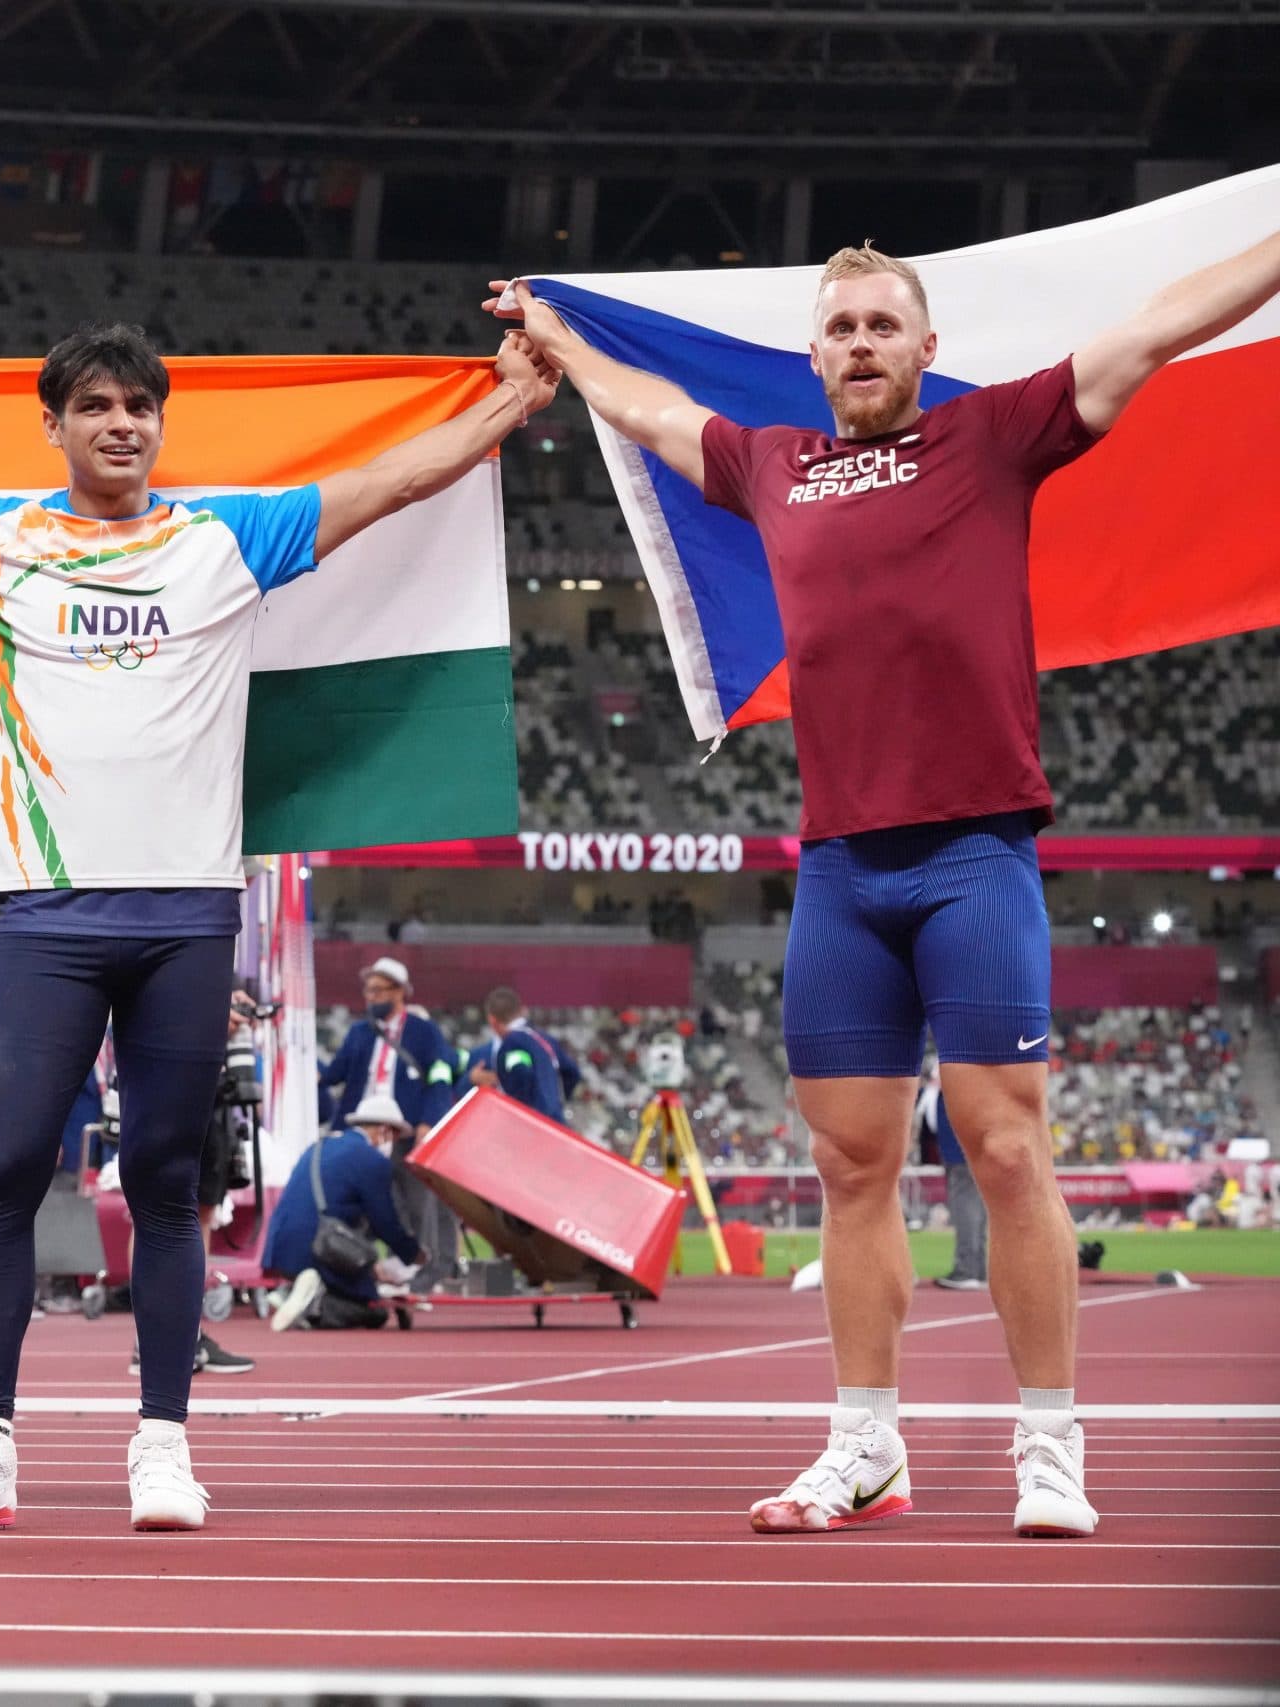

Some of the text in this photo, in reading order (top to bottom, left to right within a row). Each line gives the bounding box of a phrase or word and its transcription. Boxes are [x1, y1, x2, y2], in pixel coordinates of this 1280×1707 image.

[807, 448, 896, 480] CZECH
[787, 462, 919, 504] REPUBLIC
[57, 603, 170, 636] INDIA
[518, 832, 743, 872] TOKYO 2020
